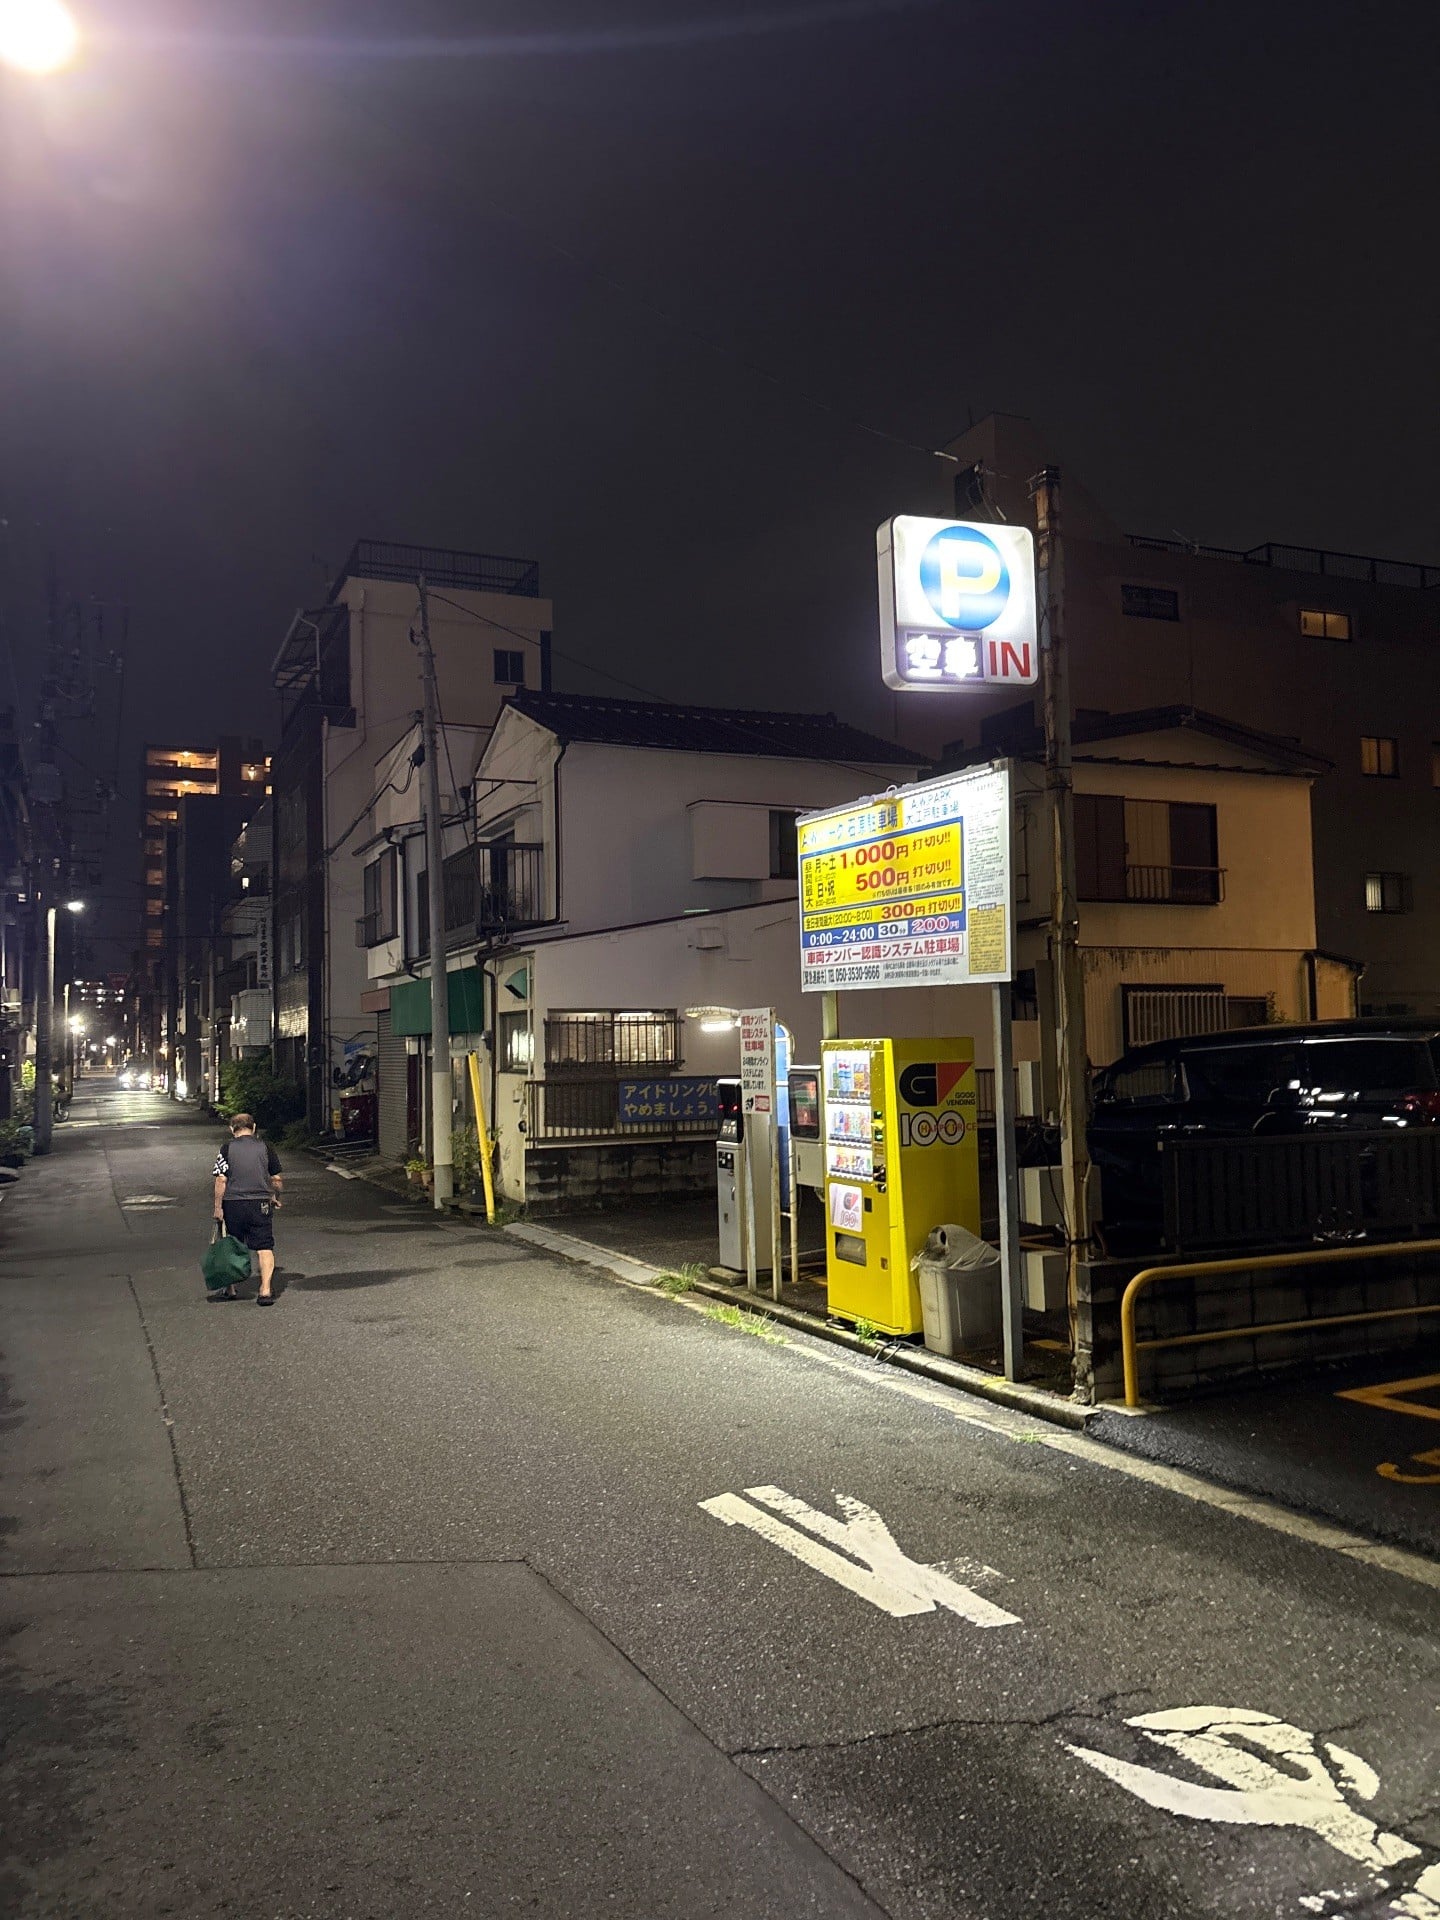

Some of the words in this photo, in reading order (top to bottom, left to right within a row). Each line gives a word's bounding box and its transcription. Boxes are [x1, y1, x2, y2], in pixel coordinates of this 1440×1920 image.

[939, 538, 1001, 619] P
[989, 641, 1031, 678] IN
[856, 867, 910, 892] 500円
[881, 902, 926, 920] 300円
[911, 916, 960, 934] 200円
[807, 937, 961, 965] 車両ナンバー認識システム駐車場
[624, 1083, 719, 1099] アイドリングは
[955, 1091, 976, 1099] GOOD
[624, 1101, 715, 1118] やめましょう。
[900, 1110, 965, 1147] 100
